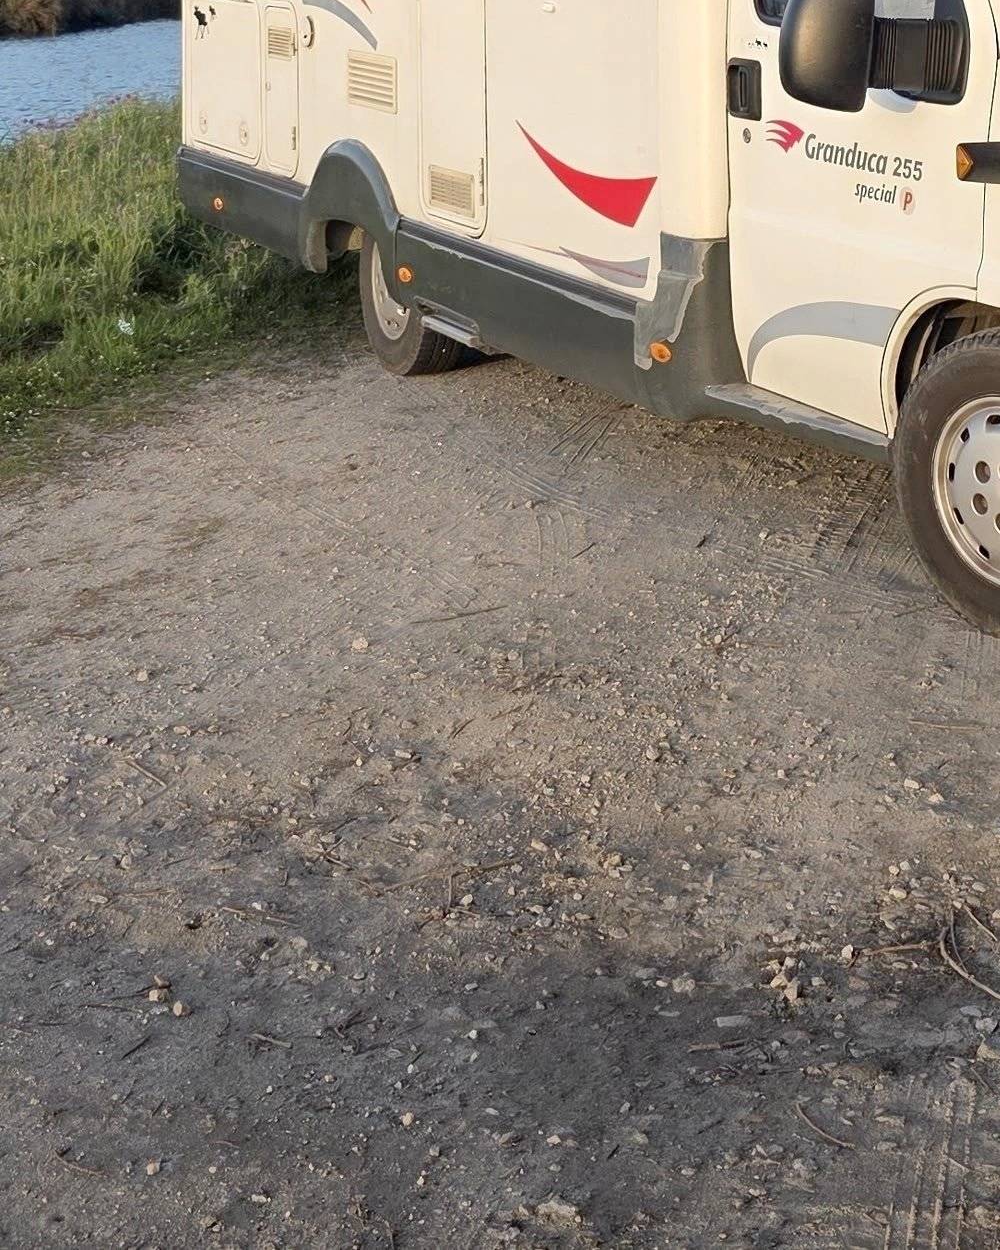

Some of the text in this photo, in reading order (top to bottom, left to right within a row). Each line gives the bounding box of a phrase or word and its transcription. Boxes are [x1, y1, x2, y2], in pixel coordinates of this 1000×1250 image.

[805, 133, 922, 181] Granduca 255
[854, 181, 913, 210] special P
